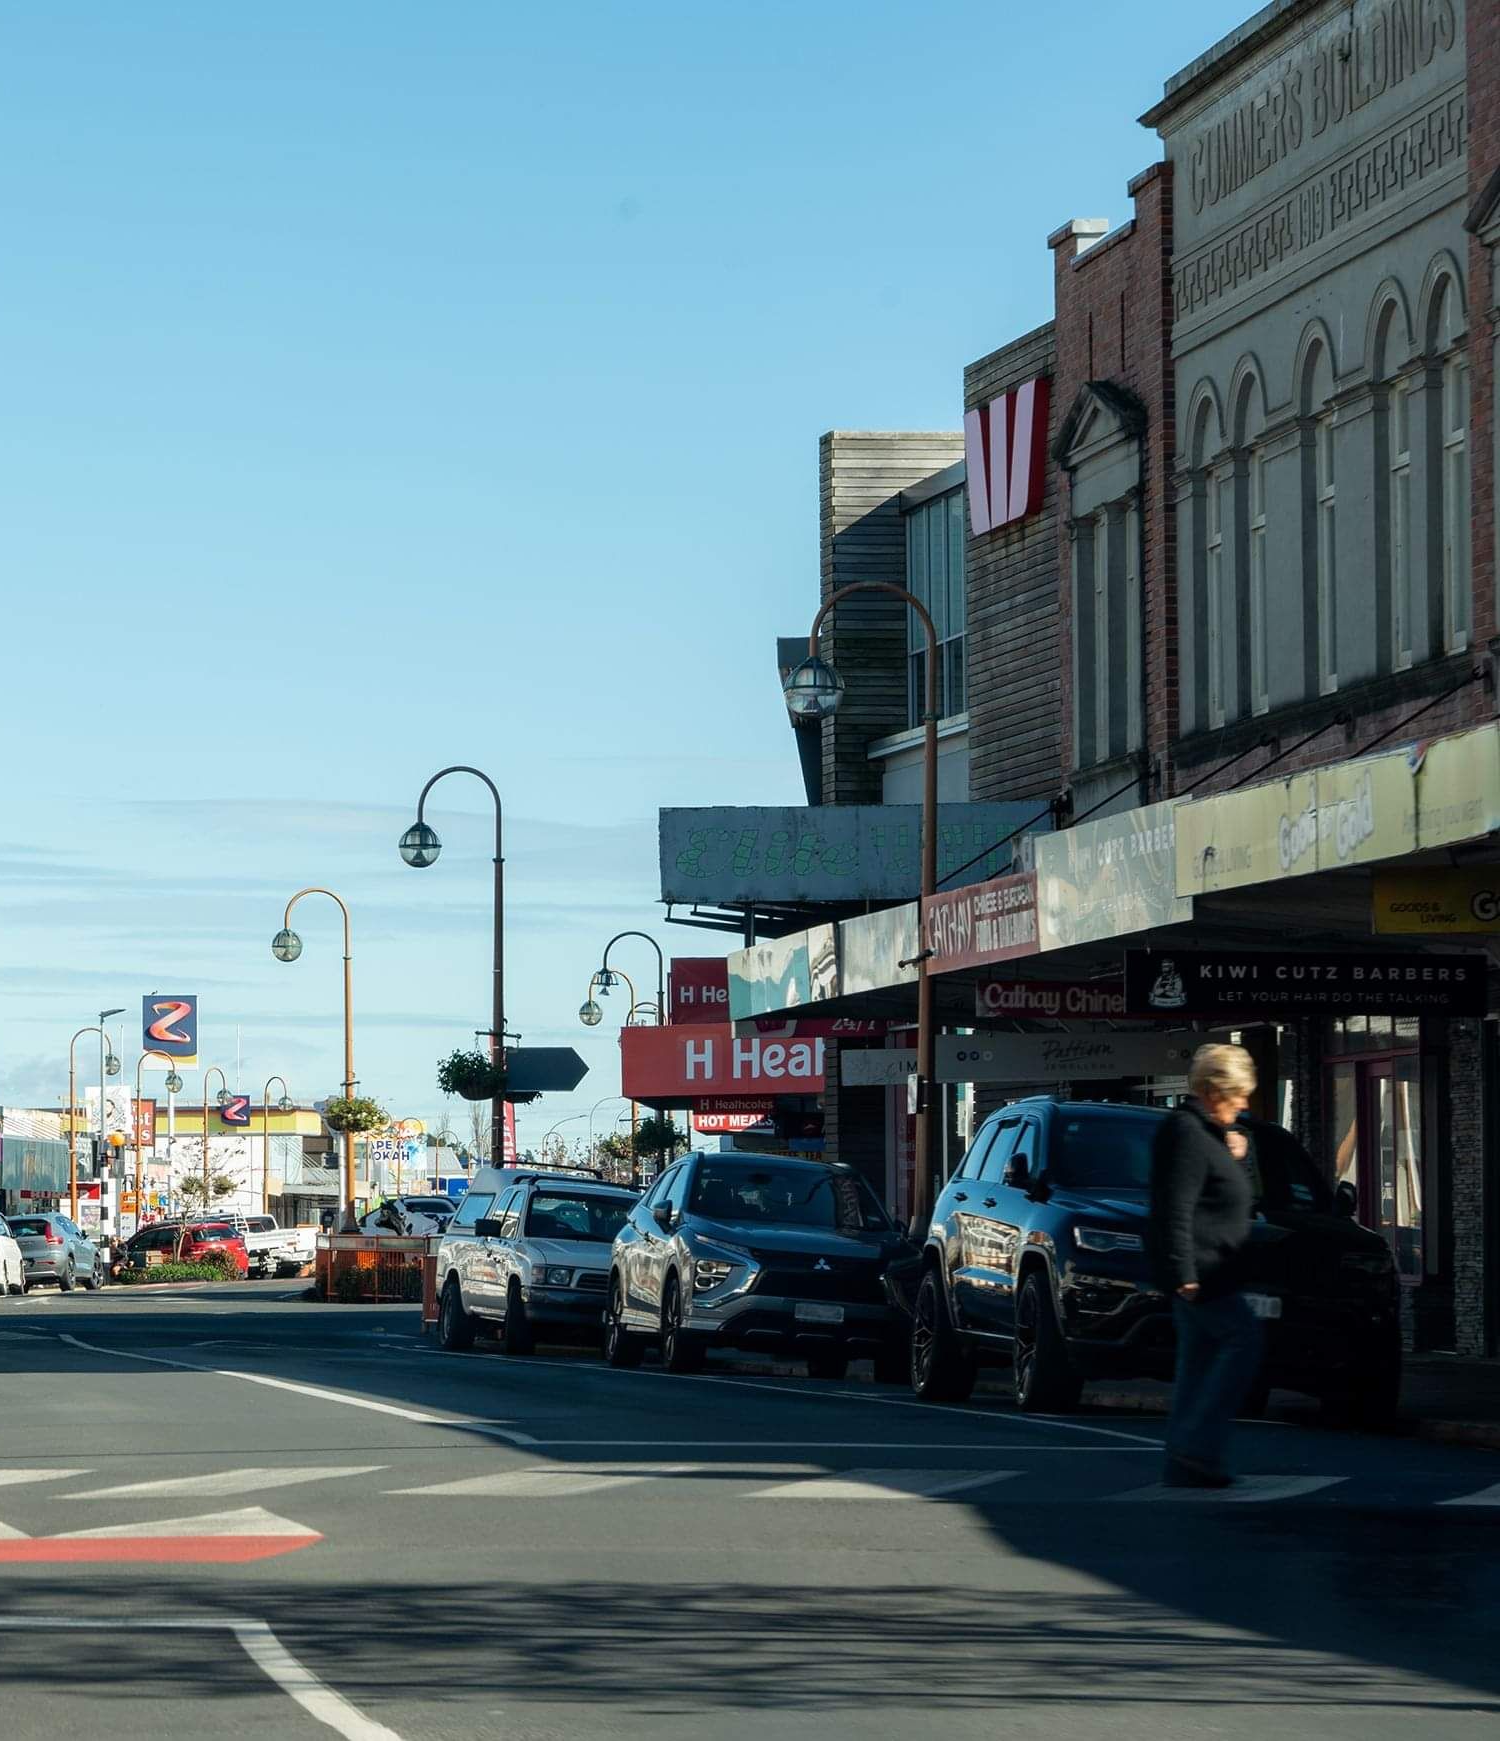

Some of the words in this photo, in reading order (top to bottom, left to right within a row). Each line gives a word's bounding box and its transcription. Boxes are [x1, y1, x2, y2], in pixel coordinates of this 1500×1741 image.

[675, 827, 862, 879] Elite
[1097, 837, 1125, 866] CUTZ
[927, 896, 971, 960] CATHAY
[1200, 964, 1258, 979] KIWI
[1275, 966, 1339, 980] CUTZ
[1353, 967, 1467, 981] BARBERS
[984, 982, 1061, 1015] Cathay
[1218, 991, 1243, 1001] LET
[1250, 991, 1291, 1001] YOUR
[1294, 992, 1327, 1002] HAIR
[1332, 992, 1351, 1003] DO
[1356, 992, 1383, 1003] THE
[1386, 992, 1449, 1003] TALKING
[715, 1098, 773, 1111] Heathcotes
[698, 1115, 725, 1127] HOT
[728, 1114, 774, 1127] MEALS
